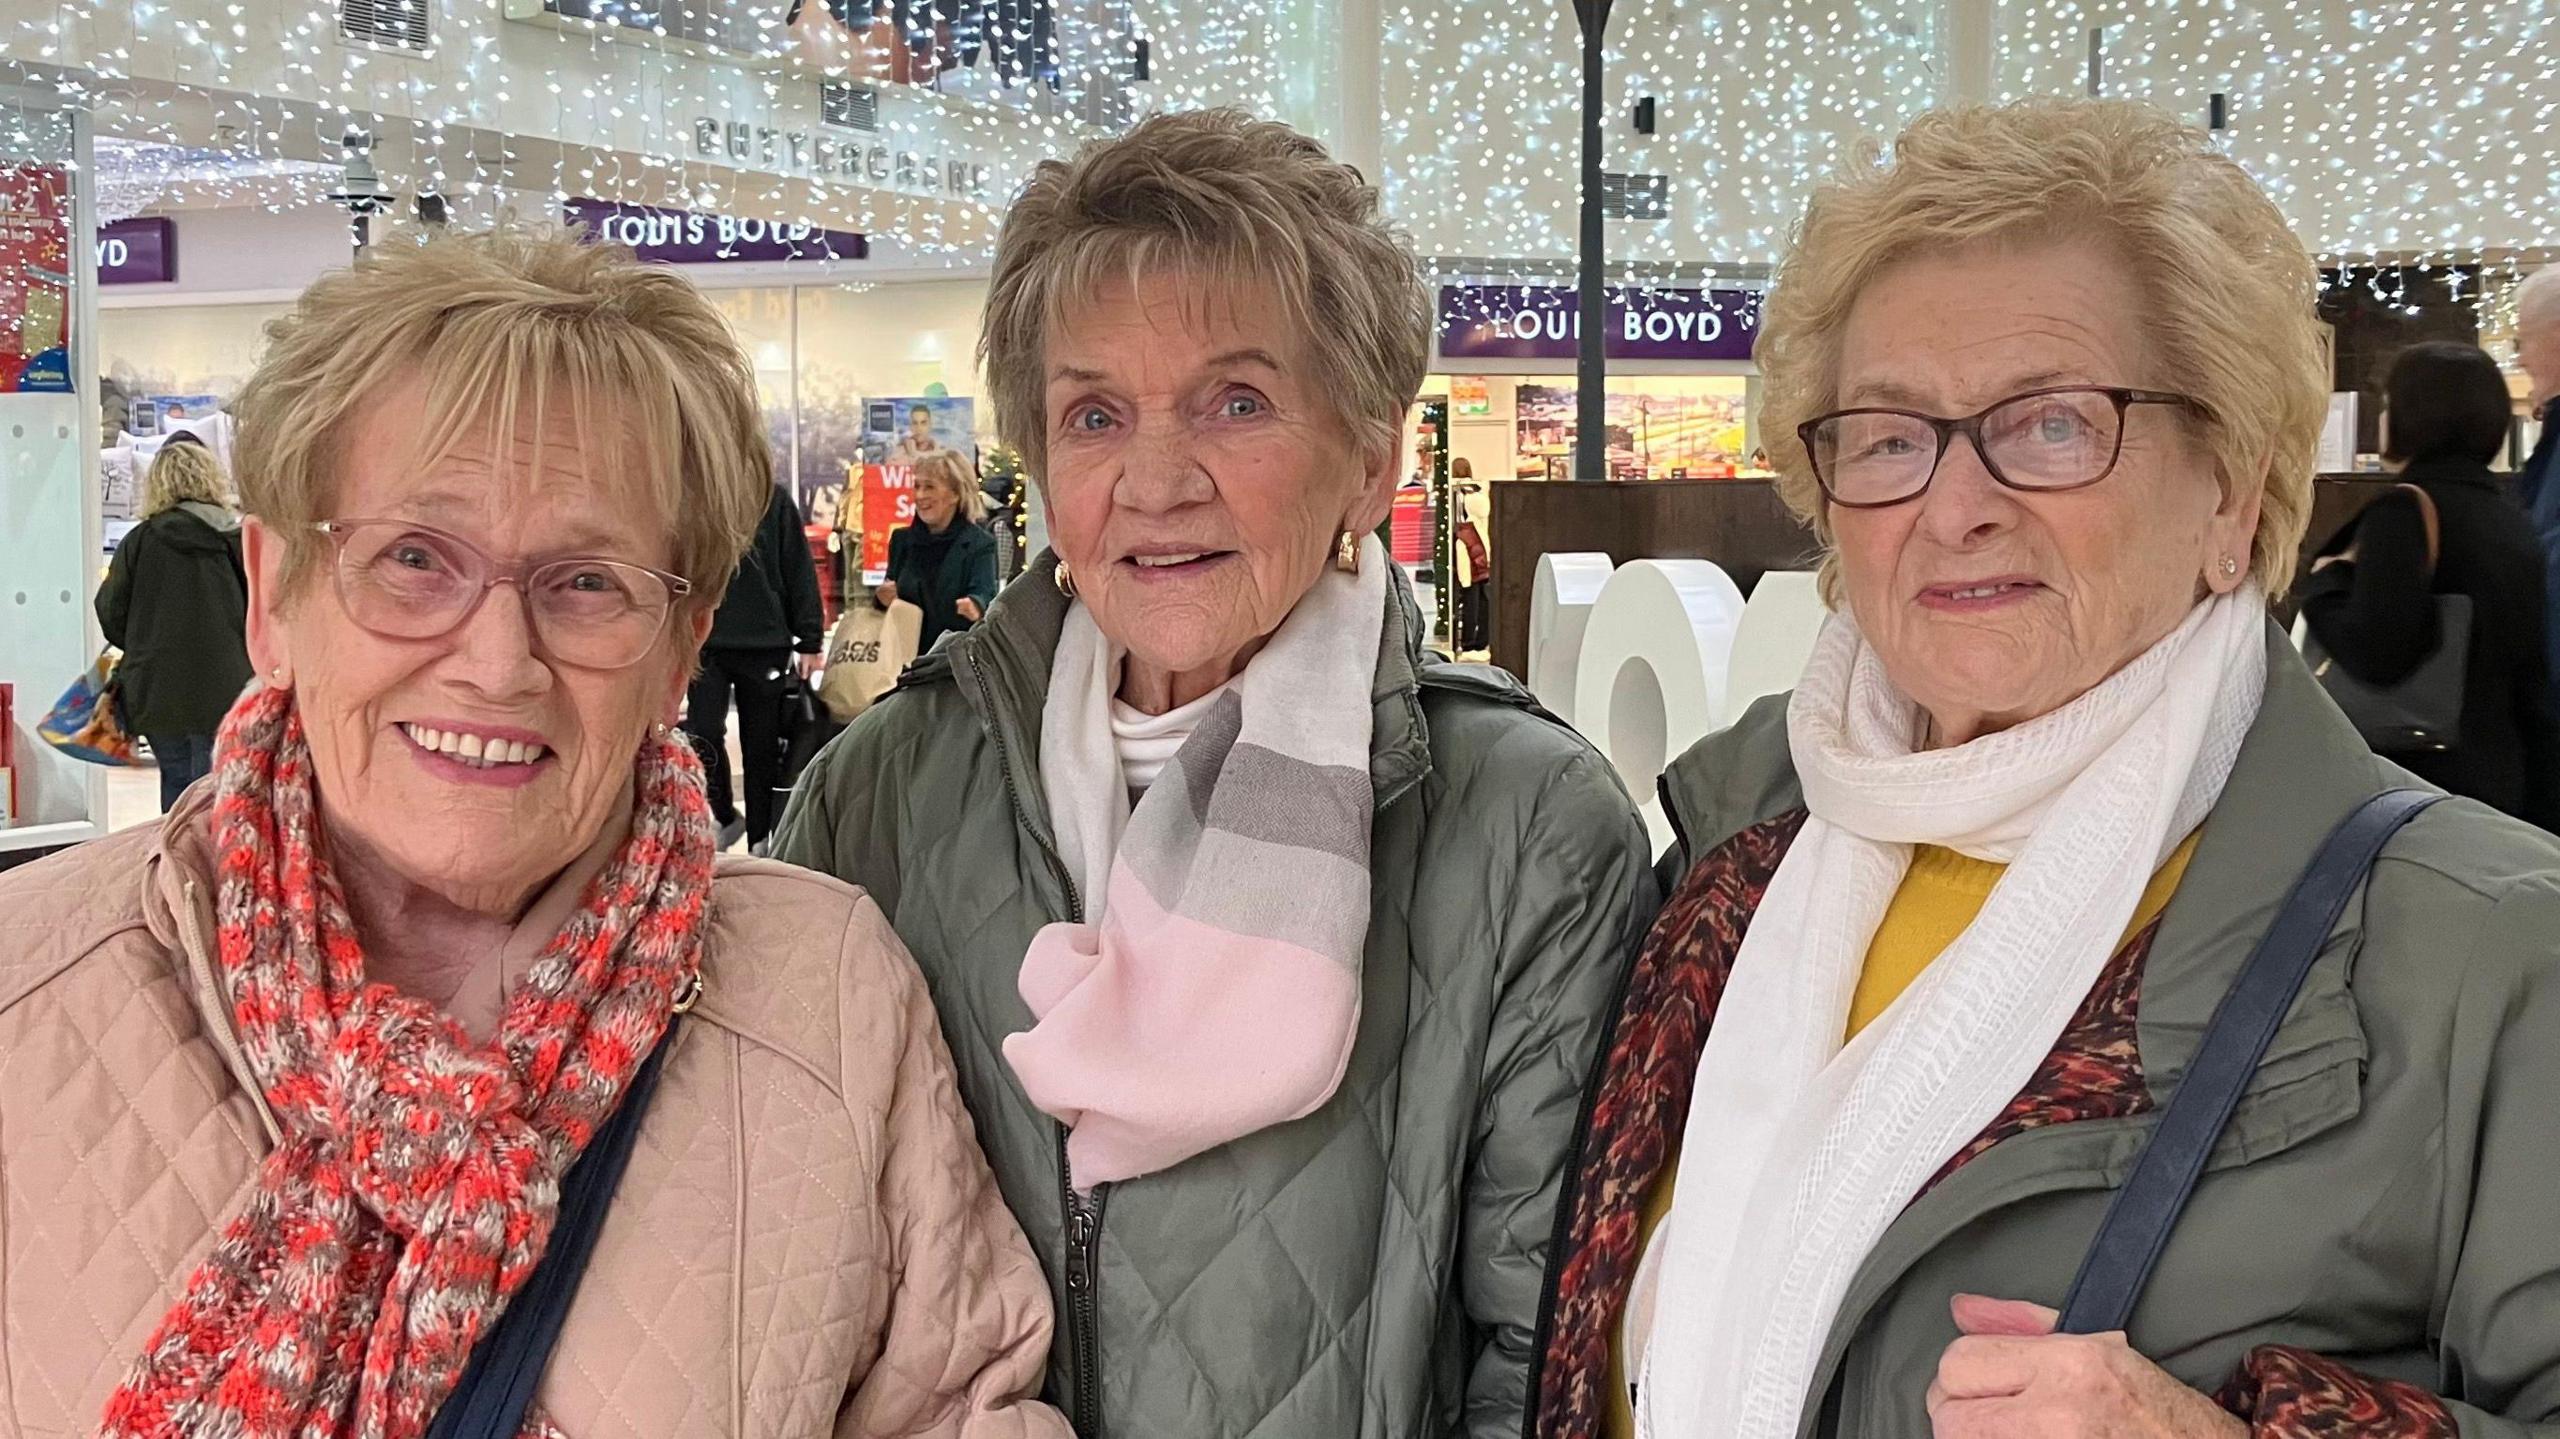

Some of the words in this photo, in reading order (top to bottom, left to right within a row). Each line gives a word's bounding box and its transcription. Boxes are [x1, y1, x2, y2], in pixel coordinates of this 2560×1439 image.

[602, 214, 704, 246] LOUIS
[717, 213, 810, 245] BOYD
[1494, 309, 1580, 340] LOUI
[1623, 310, 1722, 342] BOYD
